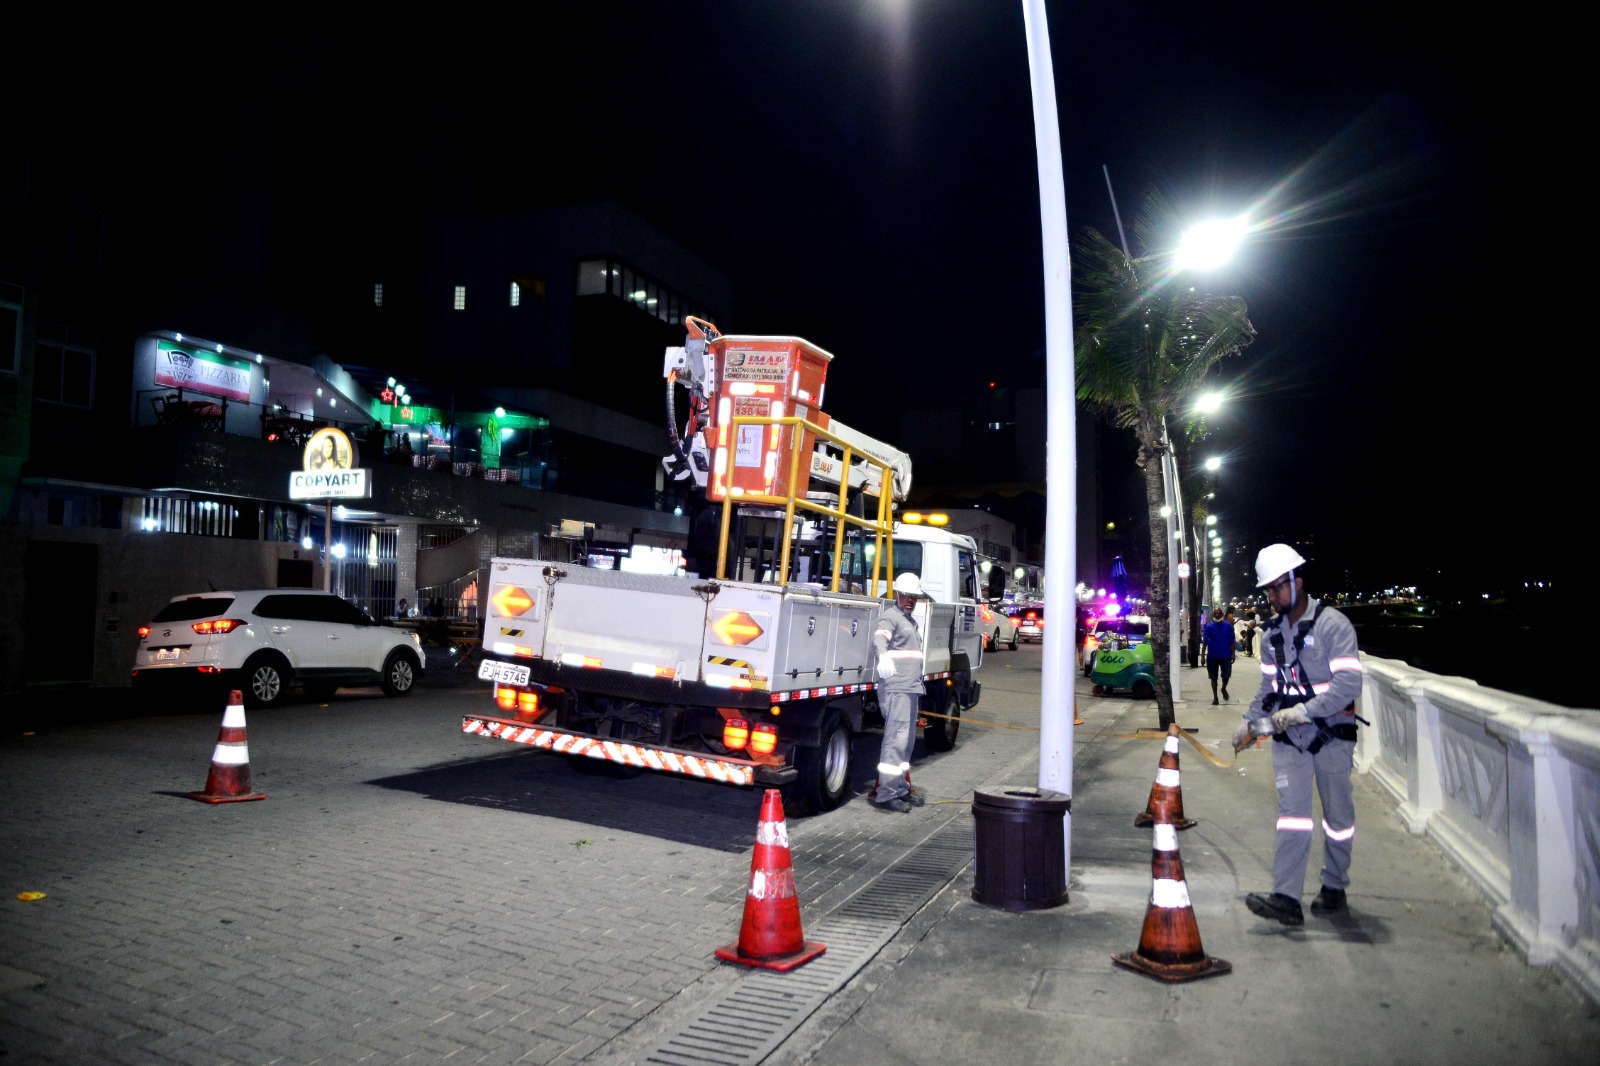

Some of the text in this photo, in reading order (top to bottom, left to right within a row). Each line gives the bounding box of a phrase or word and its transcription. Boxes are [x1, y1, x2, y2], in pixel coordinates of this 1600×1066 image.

[748, 355, 785, 366] IMAP
[200, 365, 248, 386] PIZZARIA
[735, 407, 754, 415] 136
[295, 472, 361, 487] COPYART
